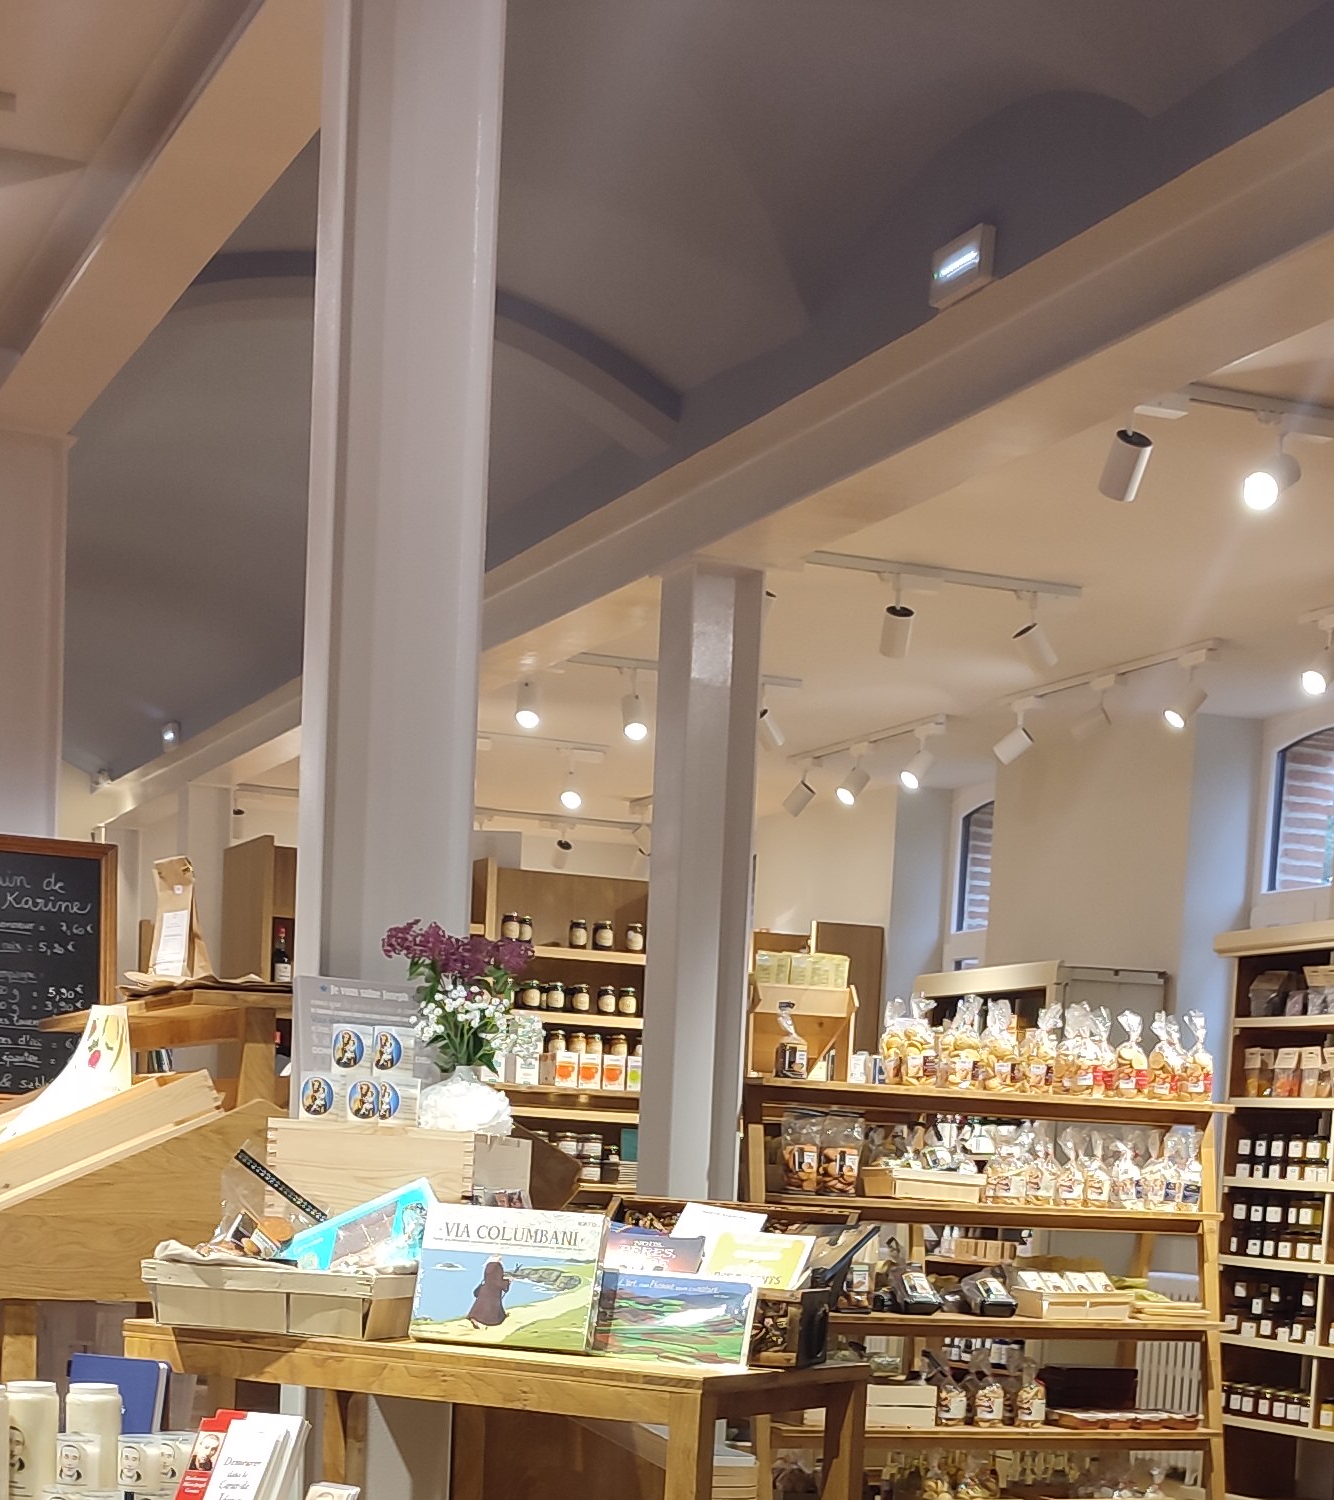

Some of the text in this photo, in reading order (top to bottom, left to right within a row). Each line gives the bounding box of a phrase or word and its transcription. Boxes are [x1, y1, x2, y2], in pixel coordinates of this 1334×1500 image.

[43, 873, 66, 894] de
[1, 892, 91, 914] Karine
[445, 1222, 471, 1239] VIA
[476, 1225, 579, 1247] COLUMBANI
